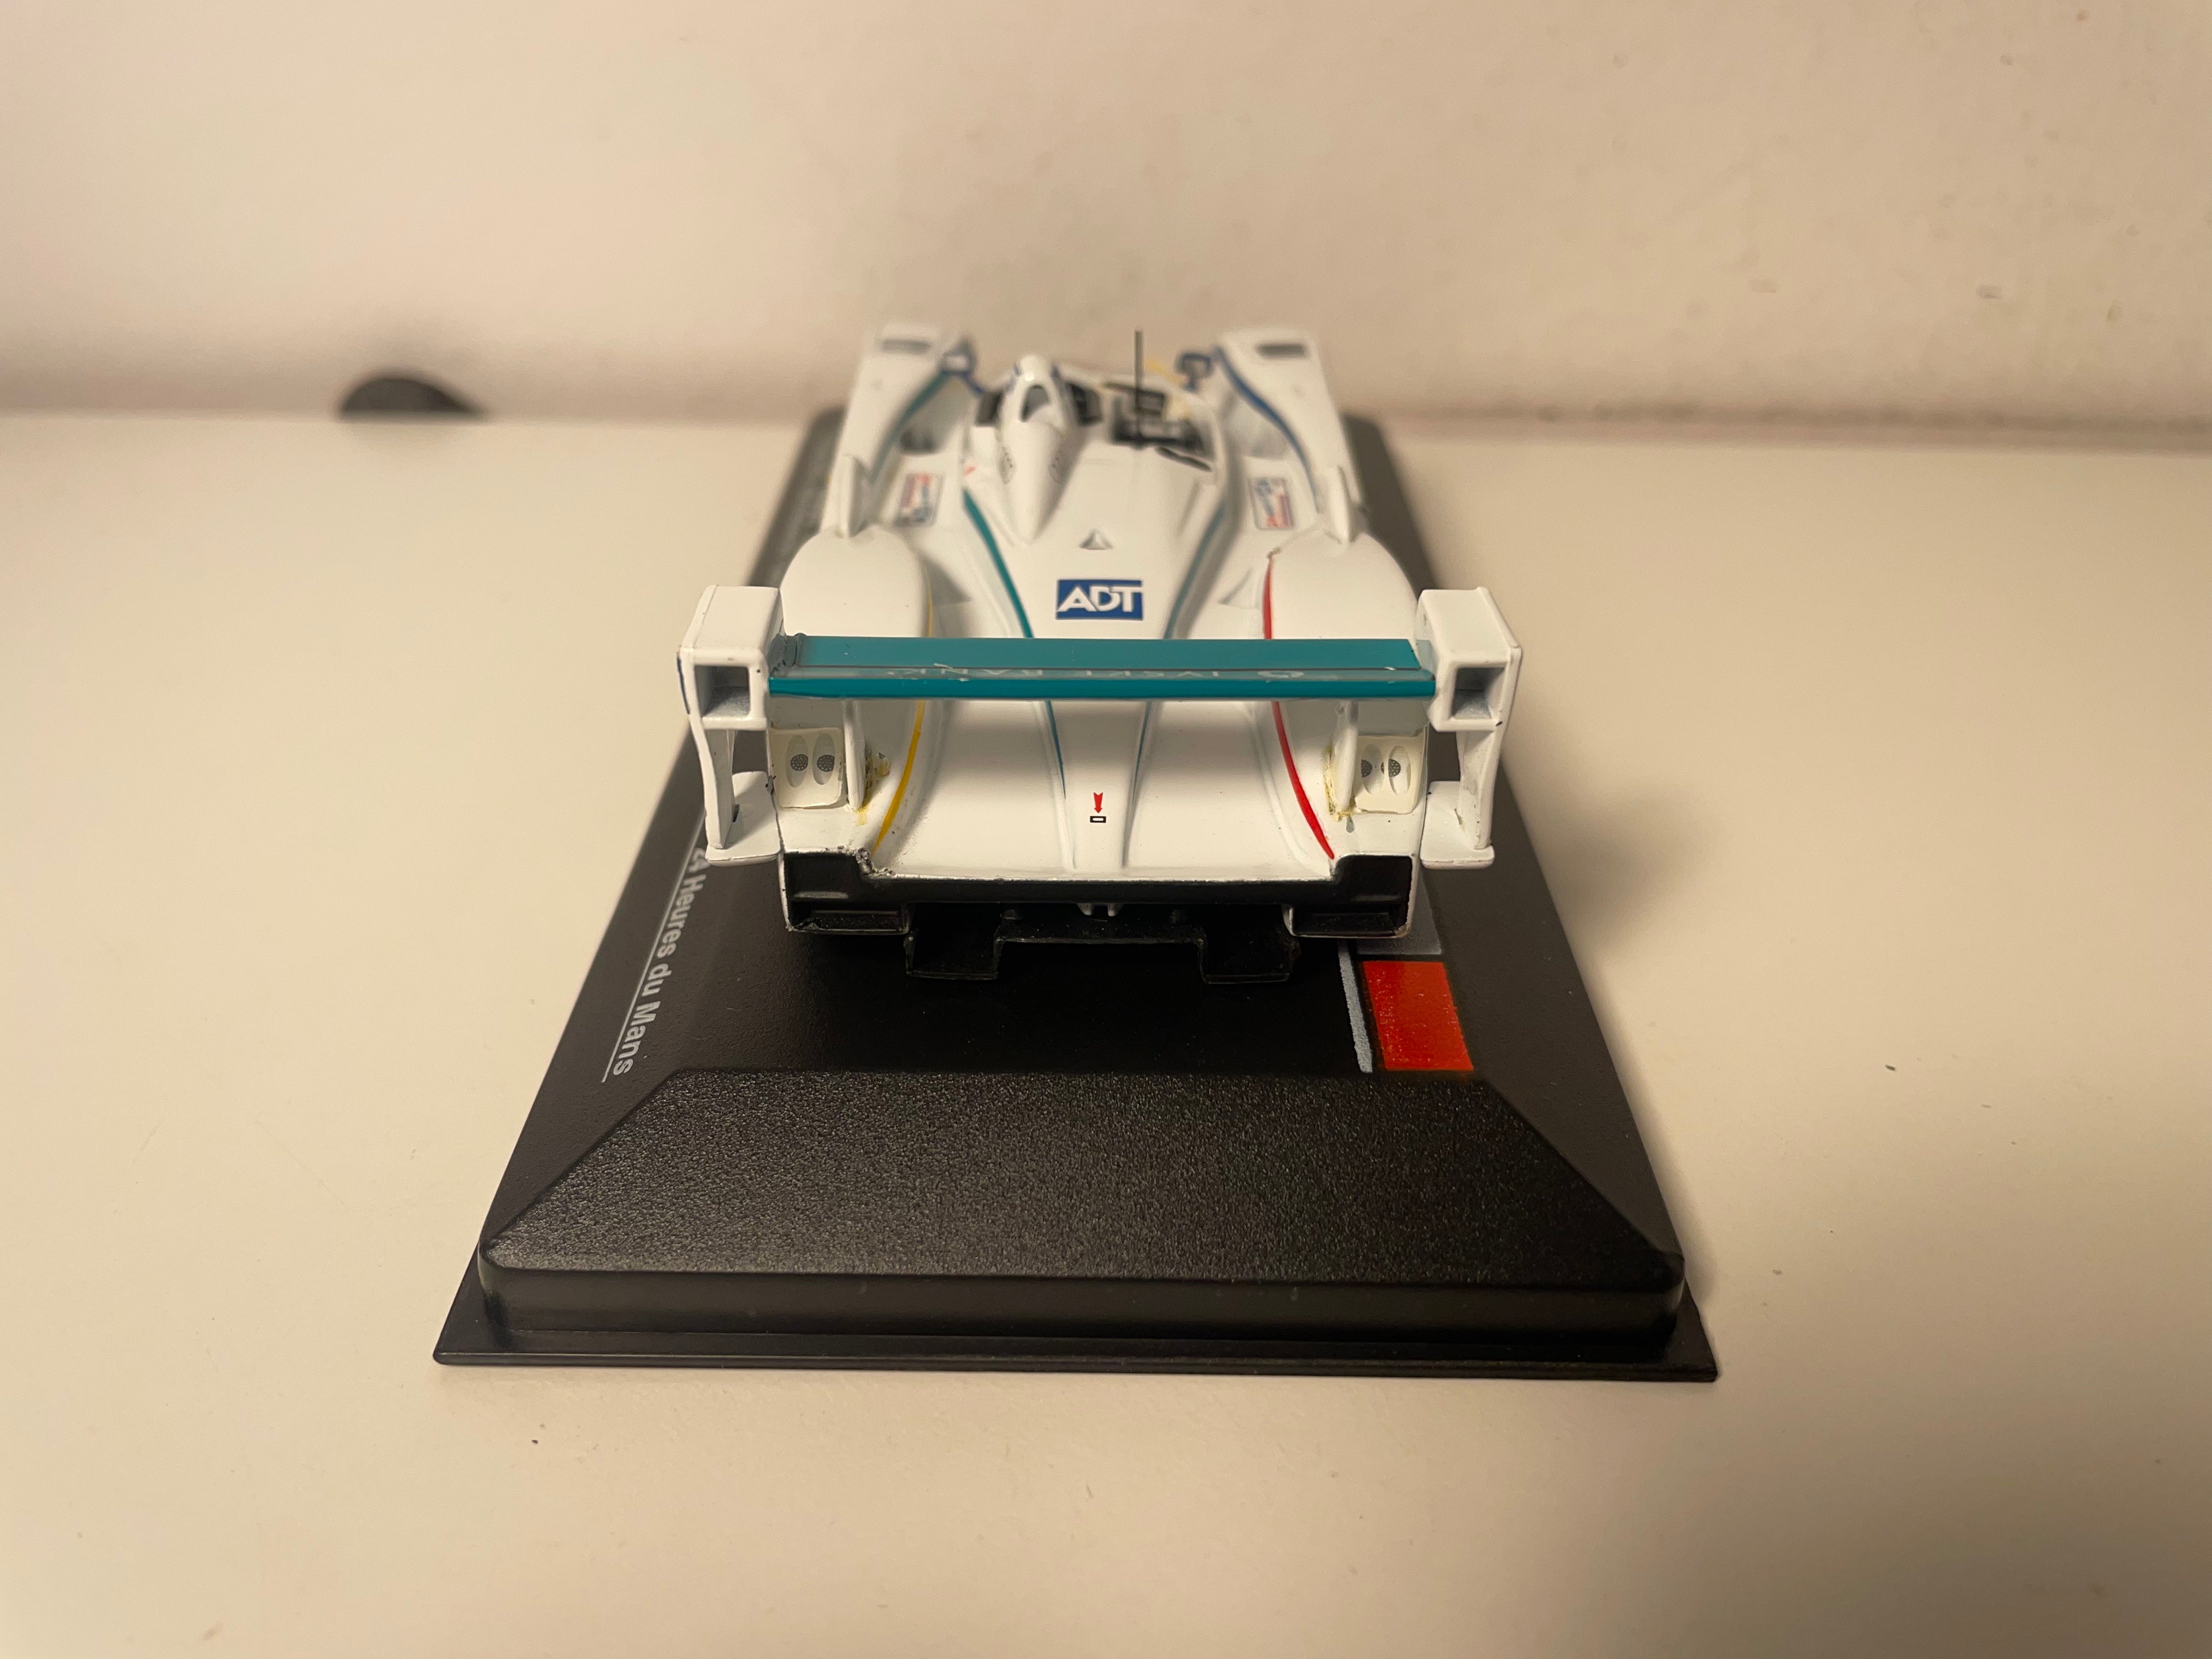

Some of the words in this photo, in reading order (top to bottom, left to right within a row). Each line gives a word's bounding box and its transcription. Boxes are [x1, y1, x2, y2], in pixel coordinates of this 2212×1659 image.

[1056, 585, 1142, 613] ADT
[657, 874, 707, 959] Heures
[642, 963, 672, 997] du
[613, 1001, 661, 1075] Mans
